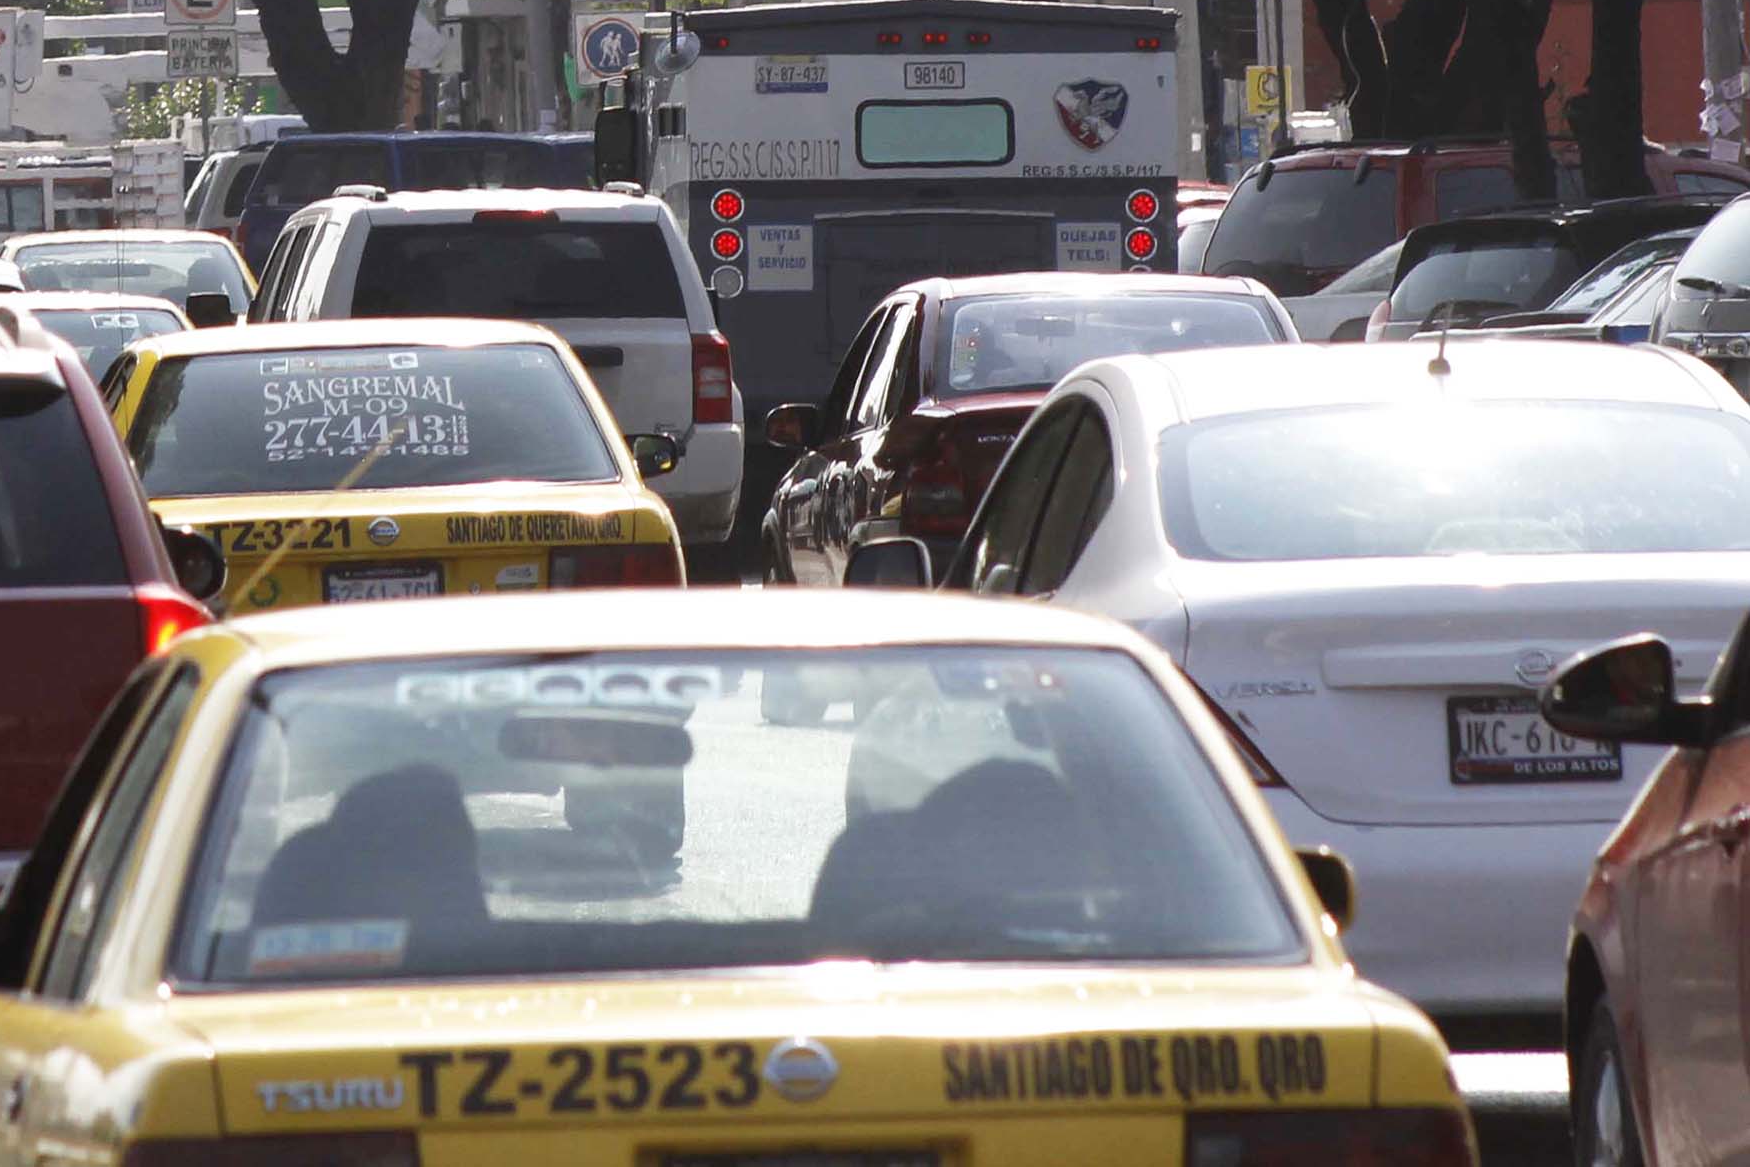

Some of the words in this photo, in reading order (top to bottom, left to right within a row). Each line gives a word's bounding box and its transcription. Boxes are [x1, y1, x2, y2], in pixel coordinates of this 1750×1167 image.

[913, 65, 956, 85] 98140
[759, 229, 801, 242] VENTAS
[1059, 230, 1117, 243] QUEJAS
[758, 256, 807, 270] SERVICIO
[263, 375, 466, 417] SANGREMAL
[205, 516, 351, 552] TZ-3221
[446, 515, 507, 544] SANTIAGO
[509, 514, 525, 542] DE
[1538, 759, 1568, 773] LOS
[1570, 758, 1619, 773] ALTOS
[256, 1077, 404, 1113] TSURU
[400, 1042, 763, 1117] TZ-2523
[941, 1035, 1114, 1102] SANTIAGO
[1119, 1034, 1164, 1096] DE
